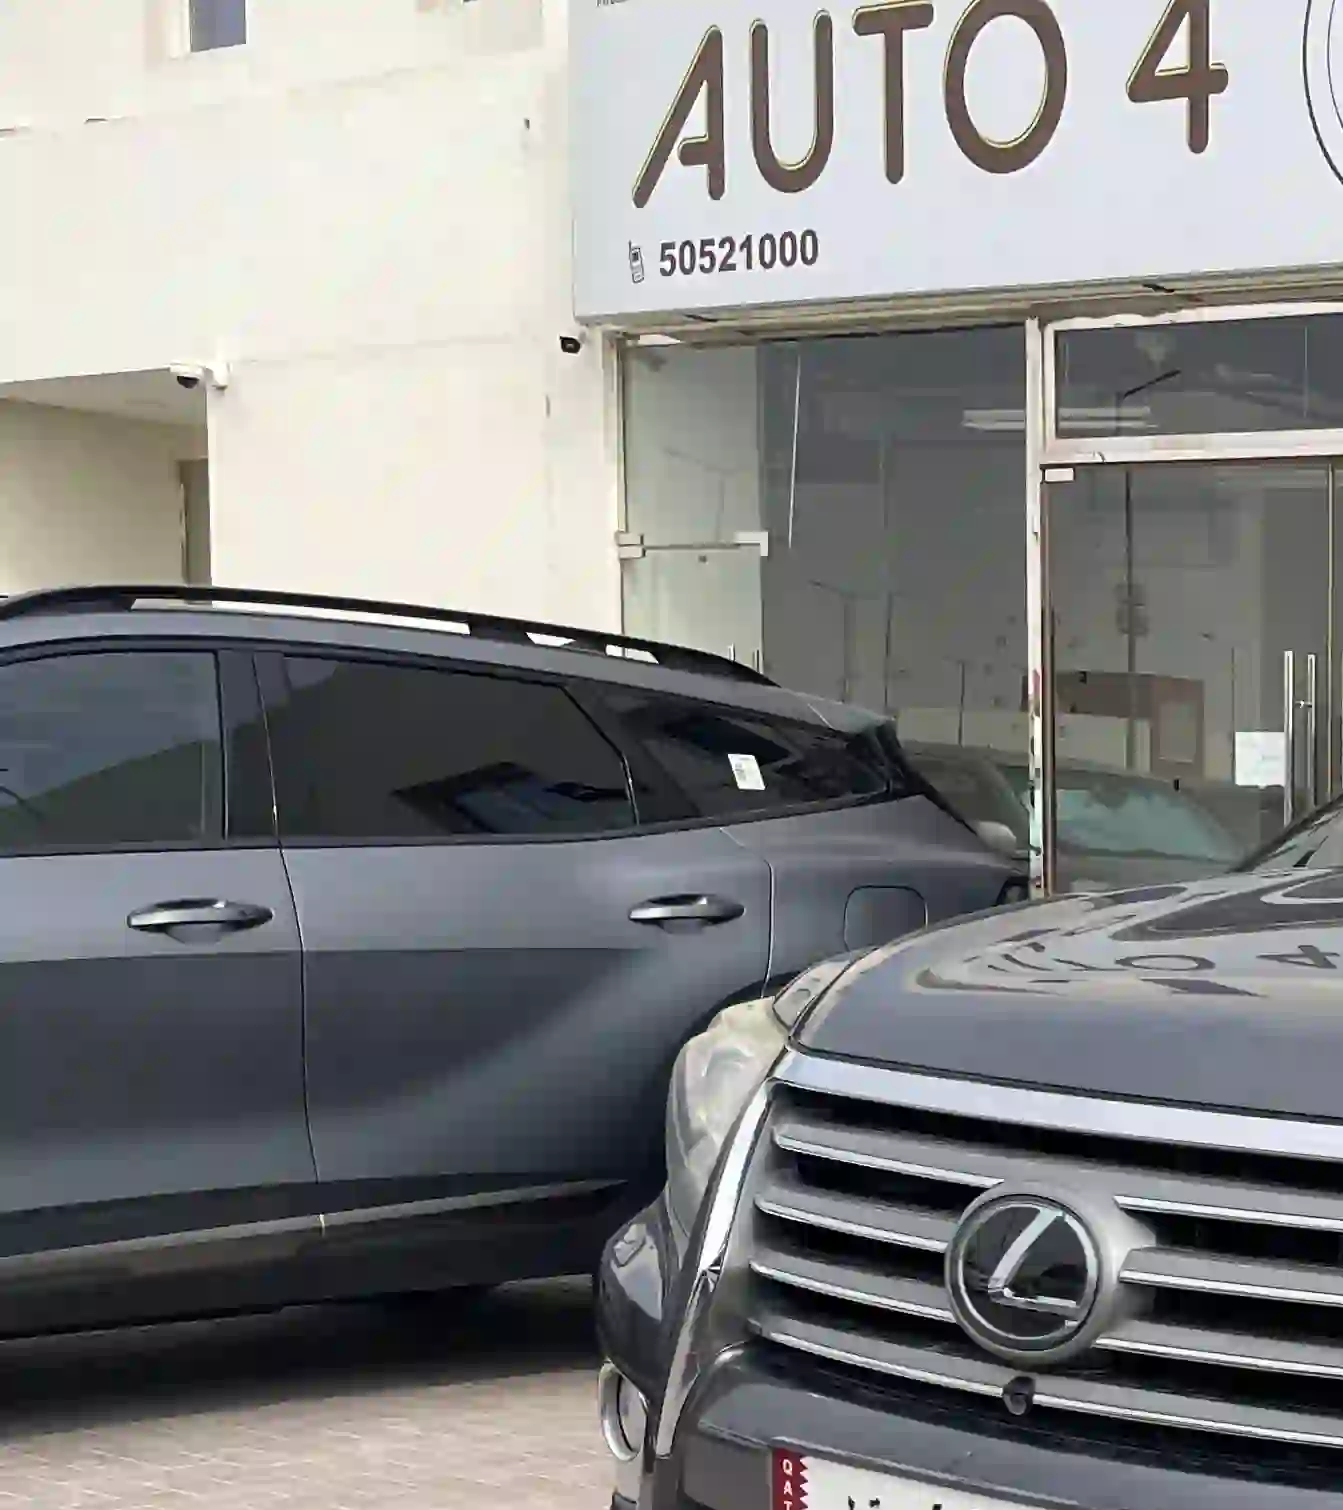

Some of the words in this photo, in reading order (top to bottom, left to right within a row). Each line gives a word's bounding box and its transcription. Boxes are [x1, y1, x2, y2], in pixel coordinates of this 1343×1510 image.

[632, 0, 1067, 208] AUTO
[1126, 0, 1229, 154] 4
[659, 229, 819, 277] 50521000
